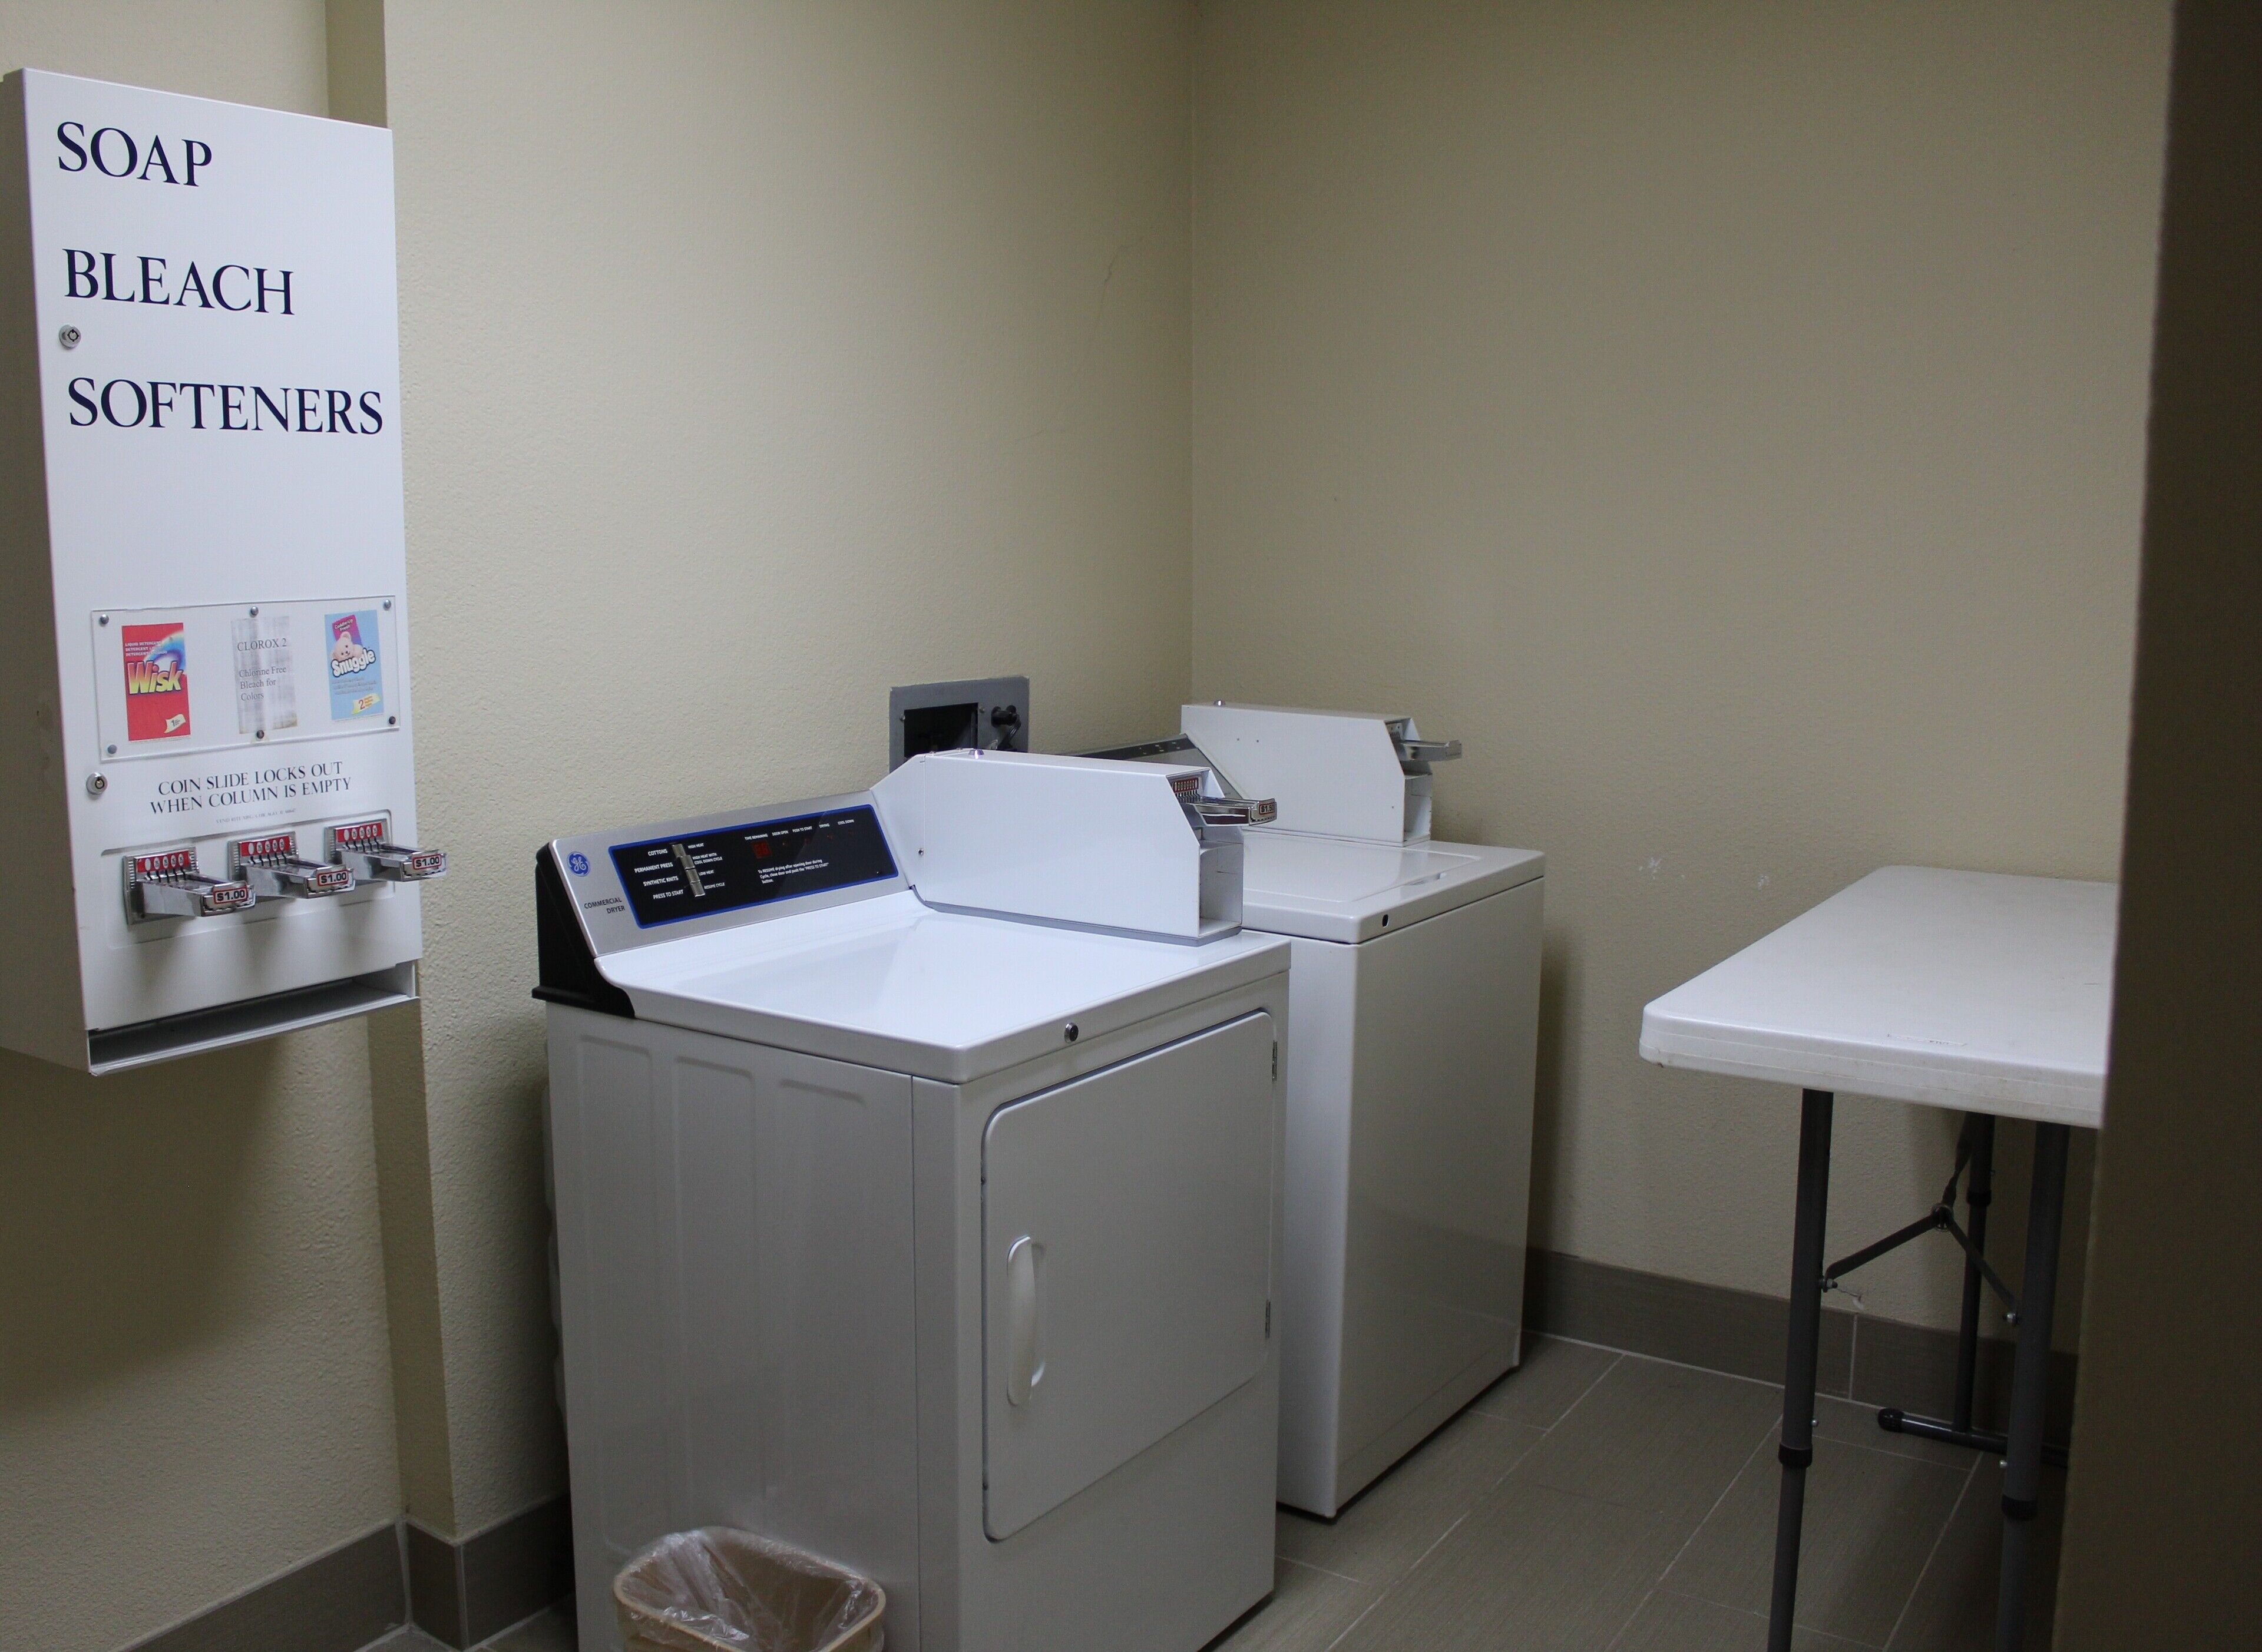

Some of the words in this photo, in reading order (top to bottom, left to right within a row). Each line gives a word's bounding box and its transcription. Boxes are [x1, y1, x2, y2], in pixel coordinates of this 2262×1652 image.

[57, 121, 212, 187] SOAP
[62, 248, 296, 316] BLEACH
[68, 377, 384, 435] SOFTENERS
[237, 638, 279, 651] CLOROX
[282, 638, 287, 647] 2
[331, 648, 376, 677] Snuggle
[127, 661, 183, 694] Wisk
[239, 666, 269, 677] Chlorine
[271, 666, 287, 674] Free
[240, 680, 264, 690] Bleach
[266, 678, 276, 687] for
[241, 692, 264, 701] Colors
[358, 699, 365, 710] 2
[158, 777, 201, 795] COIN
[207, 773, 249, 790] SLIDE
[255, 766, 306, 784] LOCKS
[311, 761, 343, 777] OUT
[149, 796, 203, 815] WHEN
[209, 786, 279, 807] COLUMN
[285, 784, 297, 798] IS
[302, 776, 352, 796] EMPTY
[415, 857, 440, 868] $1.00
[634, 864, 660, 873] PERMANENT
[320, 872, 347, 883] $1.00
[643, 878, 666, 887] SYNTHETIC
[216, 889, 246, 902] $1.00
[653, 891, 666, 899] PRESS
[584, 897, 623, 909] COMMERCIAL
[606, 905, 626, 914] DRYER
